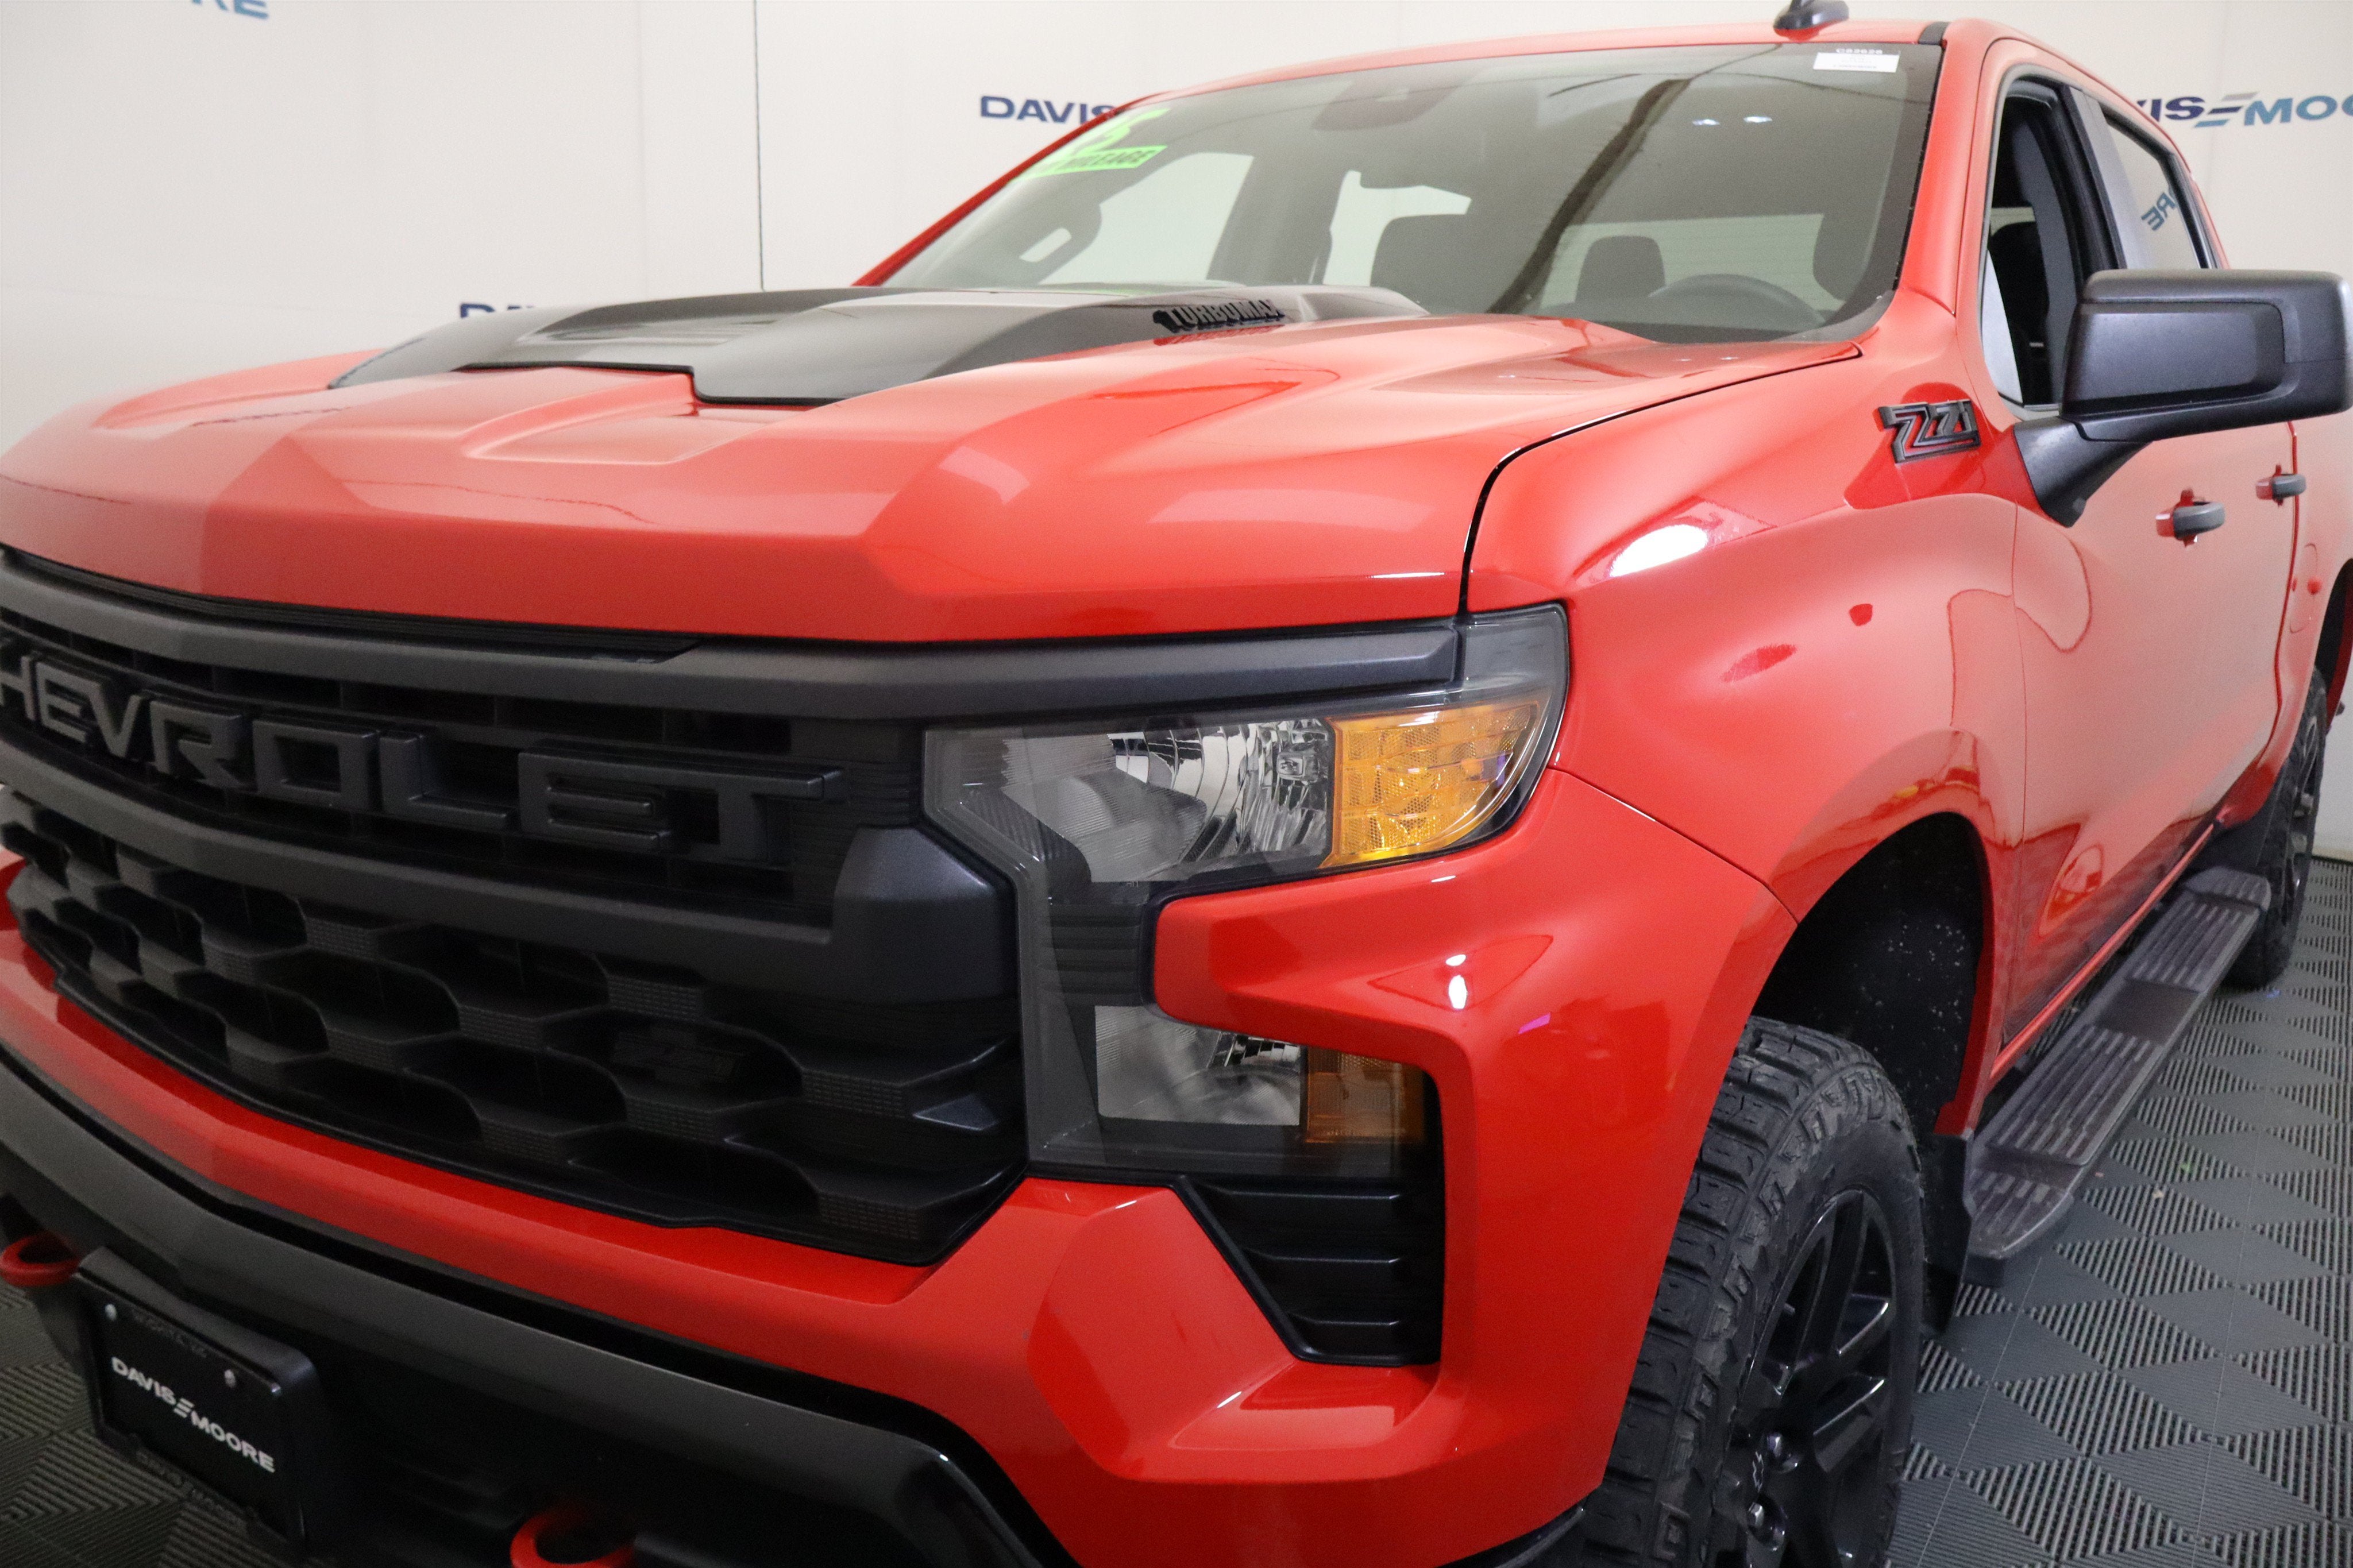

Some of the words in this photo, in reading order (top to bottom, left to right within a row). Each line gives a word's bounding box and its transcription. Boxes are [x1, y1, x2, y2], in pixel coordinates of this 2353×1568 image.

[2137, 96, 2206, 123] IS
[1153, 300, 1285, 333] TURBOMAX
[1878, 399, 1981, 464] Z71
[112, 1357, 176, 1405] DAVIS
[191, 1410, 275, 1473] MOORE
